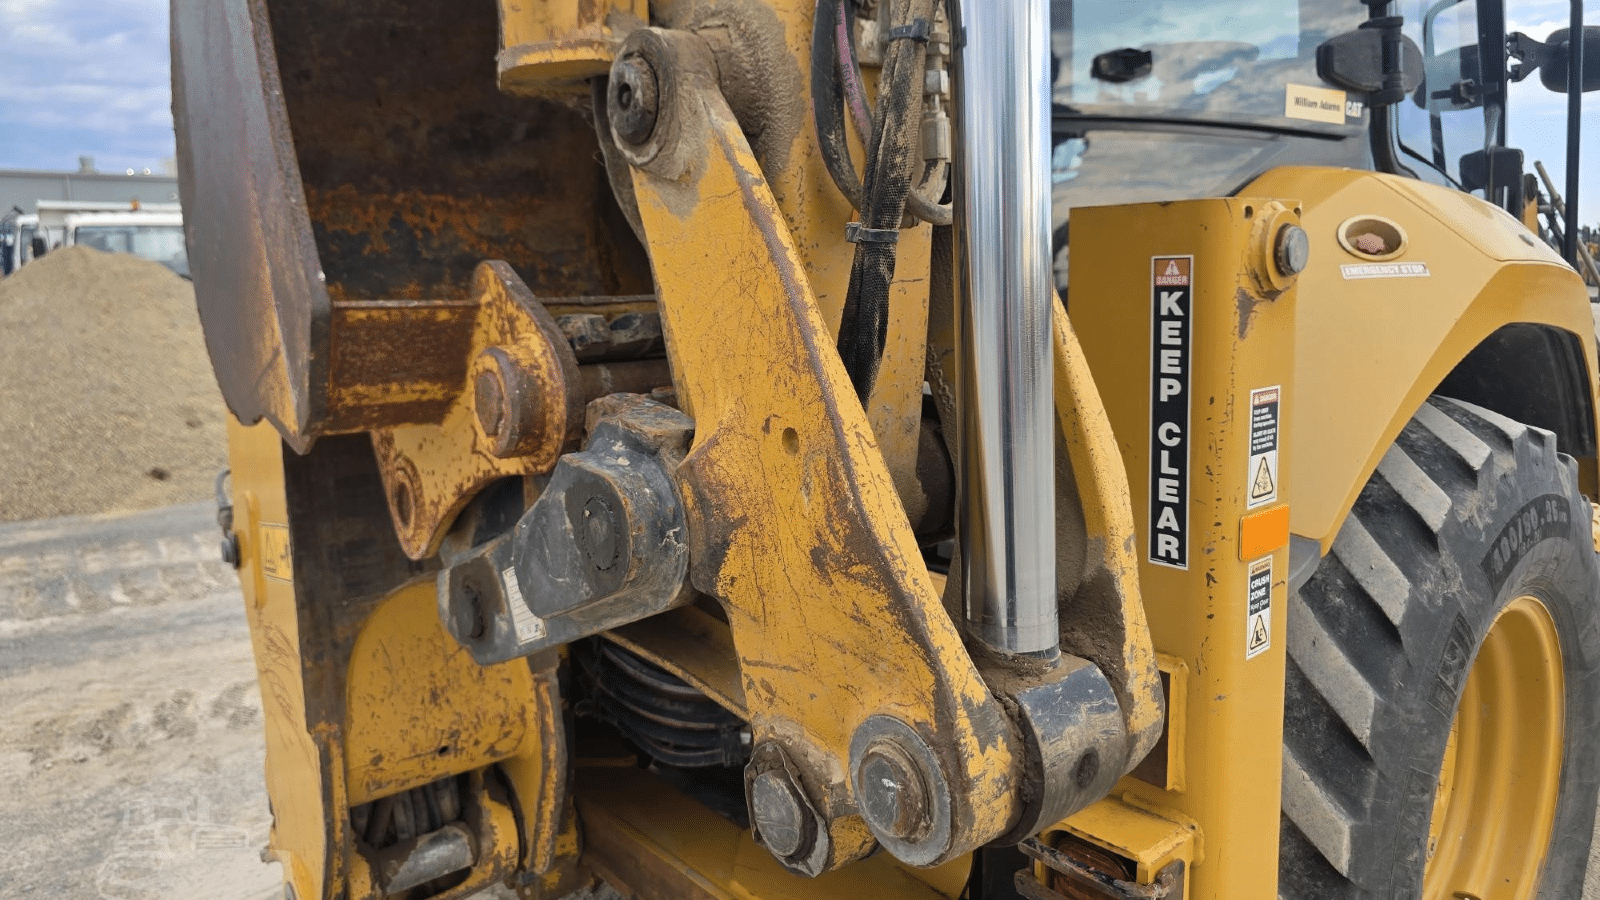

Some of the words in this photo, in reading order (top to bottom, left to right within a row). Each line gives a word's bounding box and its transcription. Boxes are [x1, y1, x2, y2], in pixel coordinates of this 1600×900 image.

[1293, 96, 1318, 108] William
[1319, 100, 1341, 112] Adams
[1346, 100, 1363, 118] CAT
[1400, 264, 1427, 275] STOP
[1159, 291, 1185, 402] KEEP
[1156, 421, 1182, 560] CLEAR
[1250, 573, 1270, 589] CRUSH
[1250, 587, 1266, 602] ZONE
